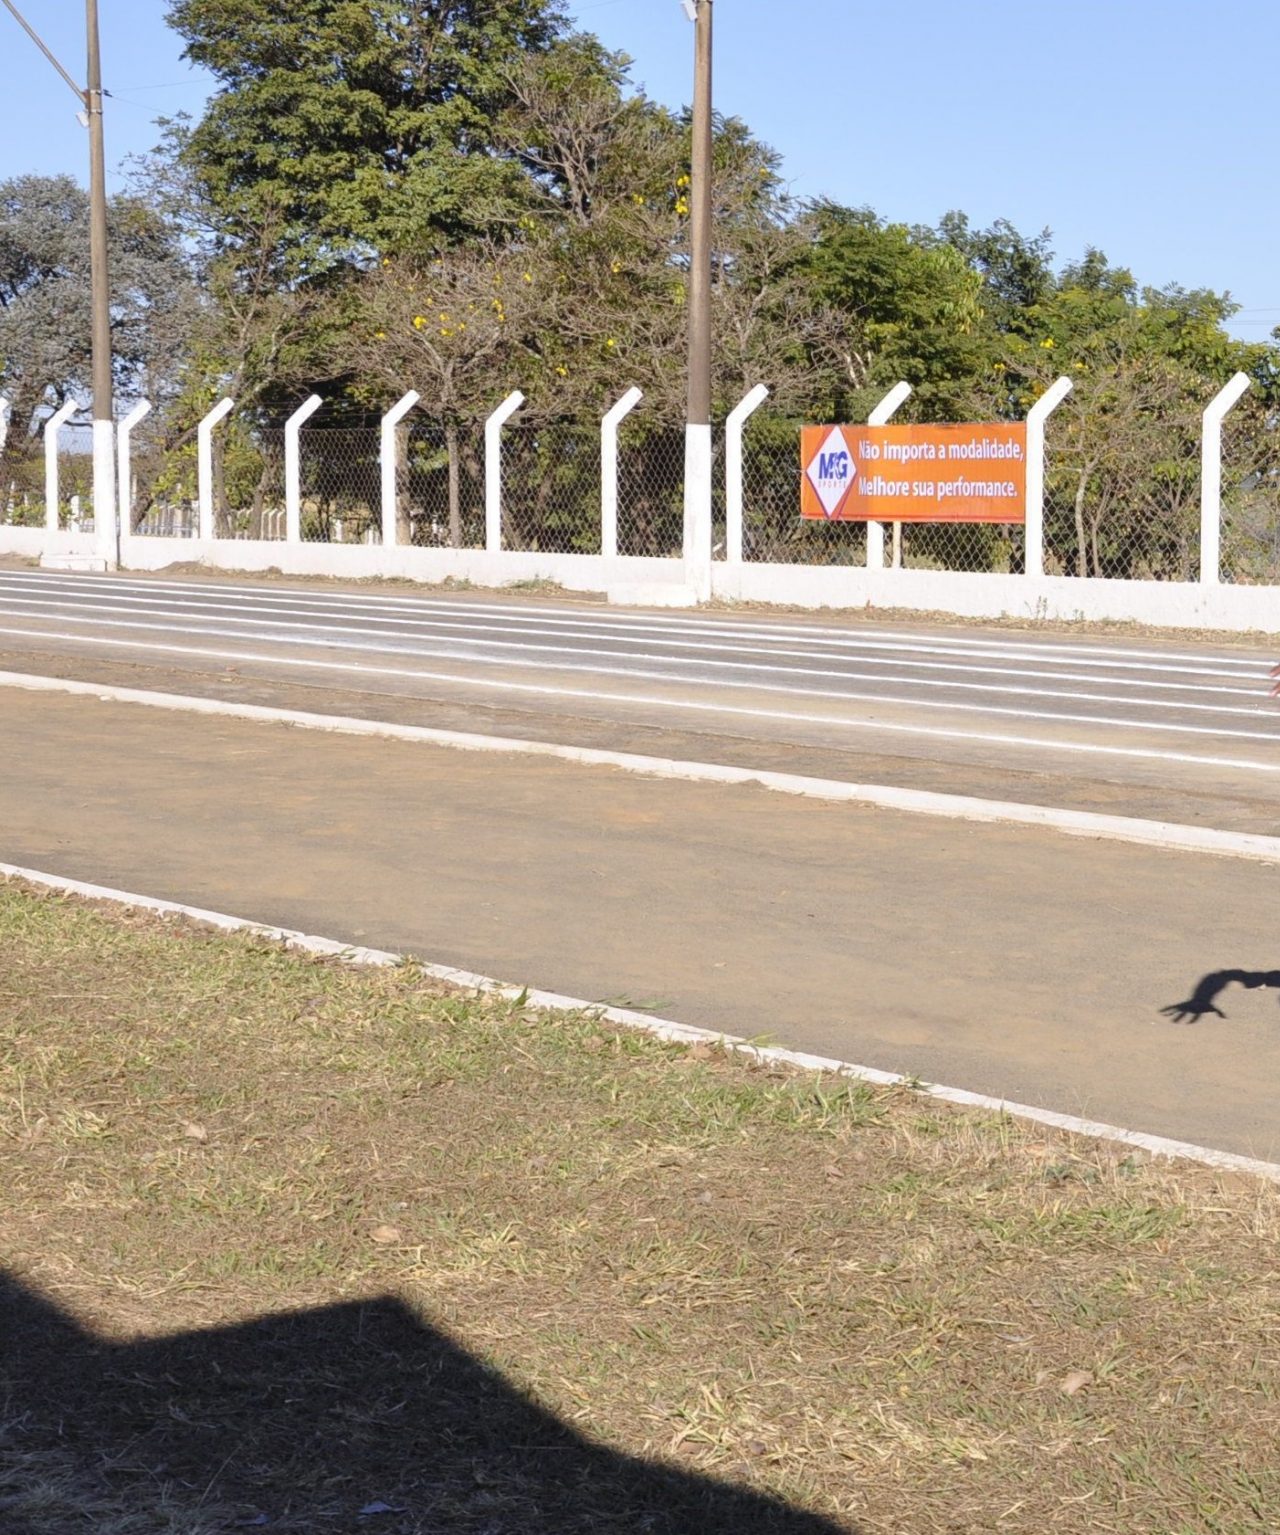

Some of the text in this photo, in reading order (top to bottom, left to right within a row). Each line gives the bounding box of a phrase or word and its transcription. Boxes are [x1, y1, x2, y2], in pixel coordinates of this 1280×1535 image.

[859, 437, 1024, 465] Não importa a modalidade,
[858, 475, 1018, 501] Melhore sua performance.
